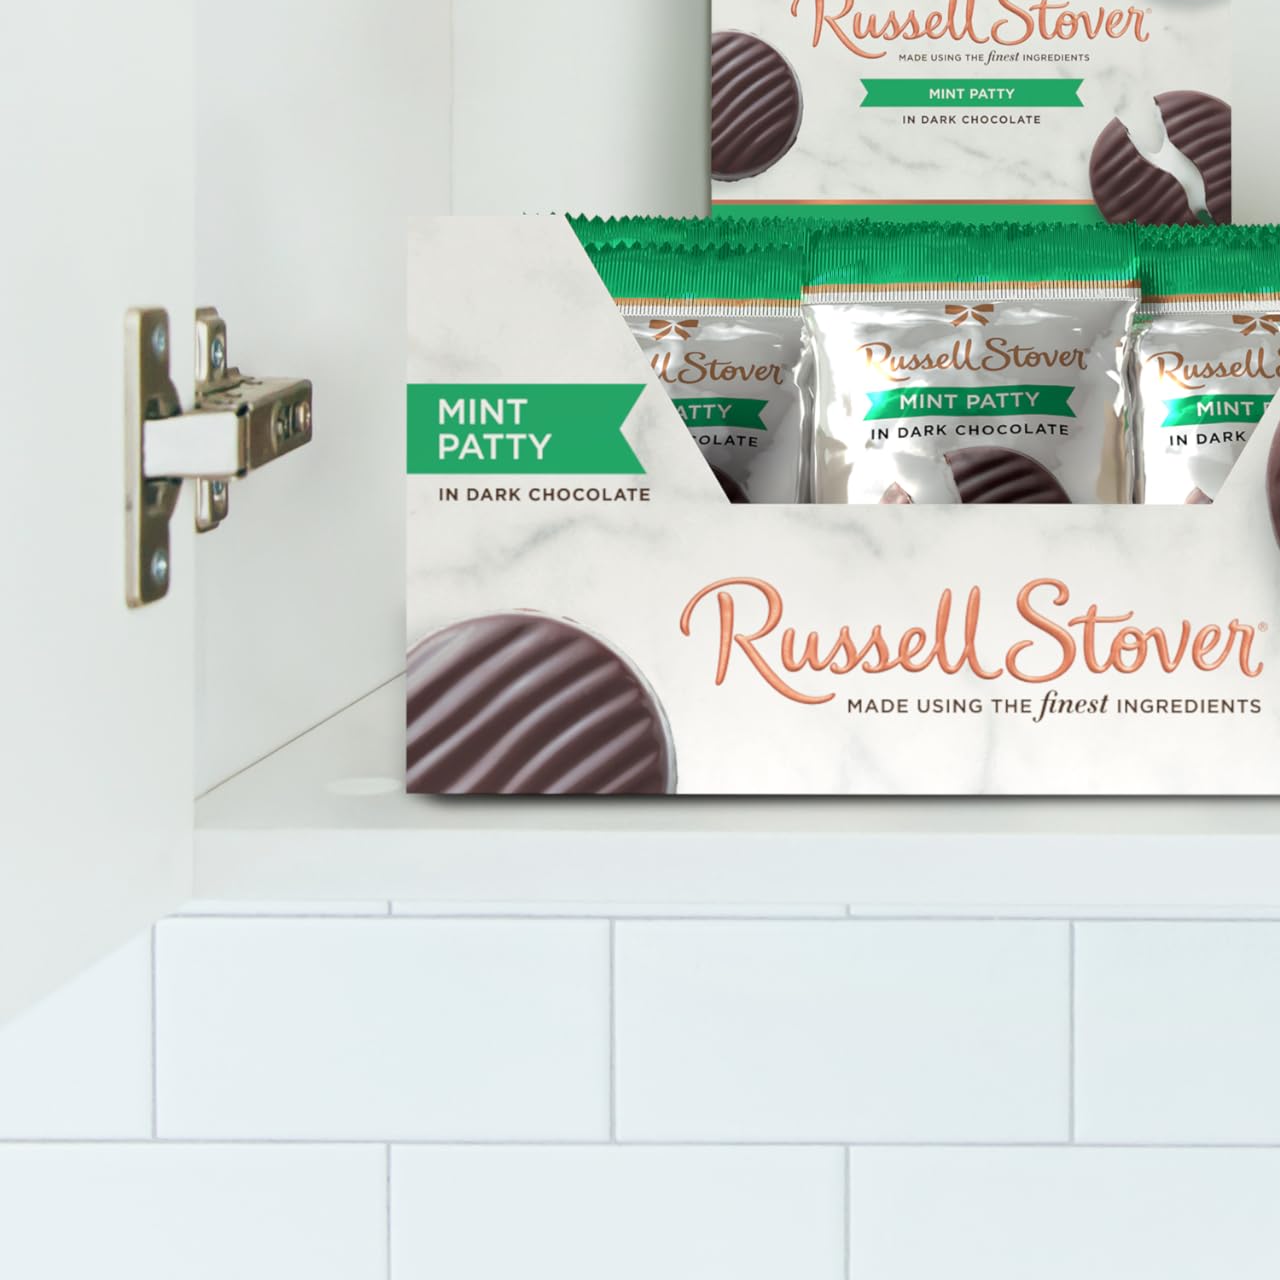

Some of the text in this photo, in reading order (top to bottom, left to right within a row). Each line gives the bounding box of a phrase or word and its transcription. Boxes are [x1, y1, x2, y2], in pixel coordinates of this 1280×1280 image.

[898, 50, 1090, 66] MADE USING THE finest INGREDIENTS
[929, 88, 1015, 100] MINT PATTY
[902, 115, 1041, 124] IN DARK CHOCOLATE
[678, 351, 784, 385] Stover
[857, 337, 1087, 382] Russell Stover
[1146, 346, 1276, 390] Russell
[900, 391, 1040, 410] MINT PATTY
[1196, 401, 1255, 417] MINT
[438, 398, 529, 425] MINT
[676, 404, 732, 420] ATTY
[871, 423, 1069, 440] IN DARK CHOCOLATE
[1170, 431, 1246, 446] IN DARK
[438, 433, 552, 461] PATTY
[692, 434, 758, 448] OLATE
[438, 487, 651, 502] IN DARK CHOCOLATE
[680, 576, 1265, 705] Russell Stover
[847, 689, 1263, 723] MADE USING THE finest INGREDIENTS
